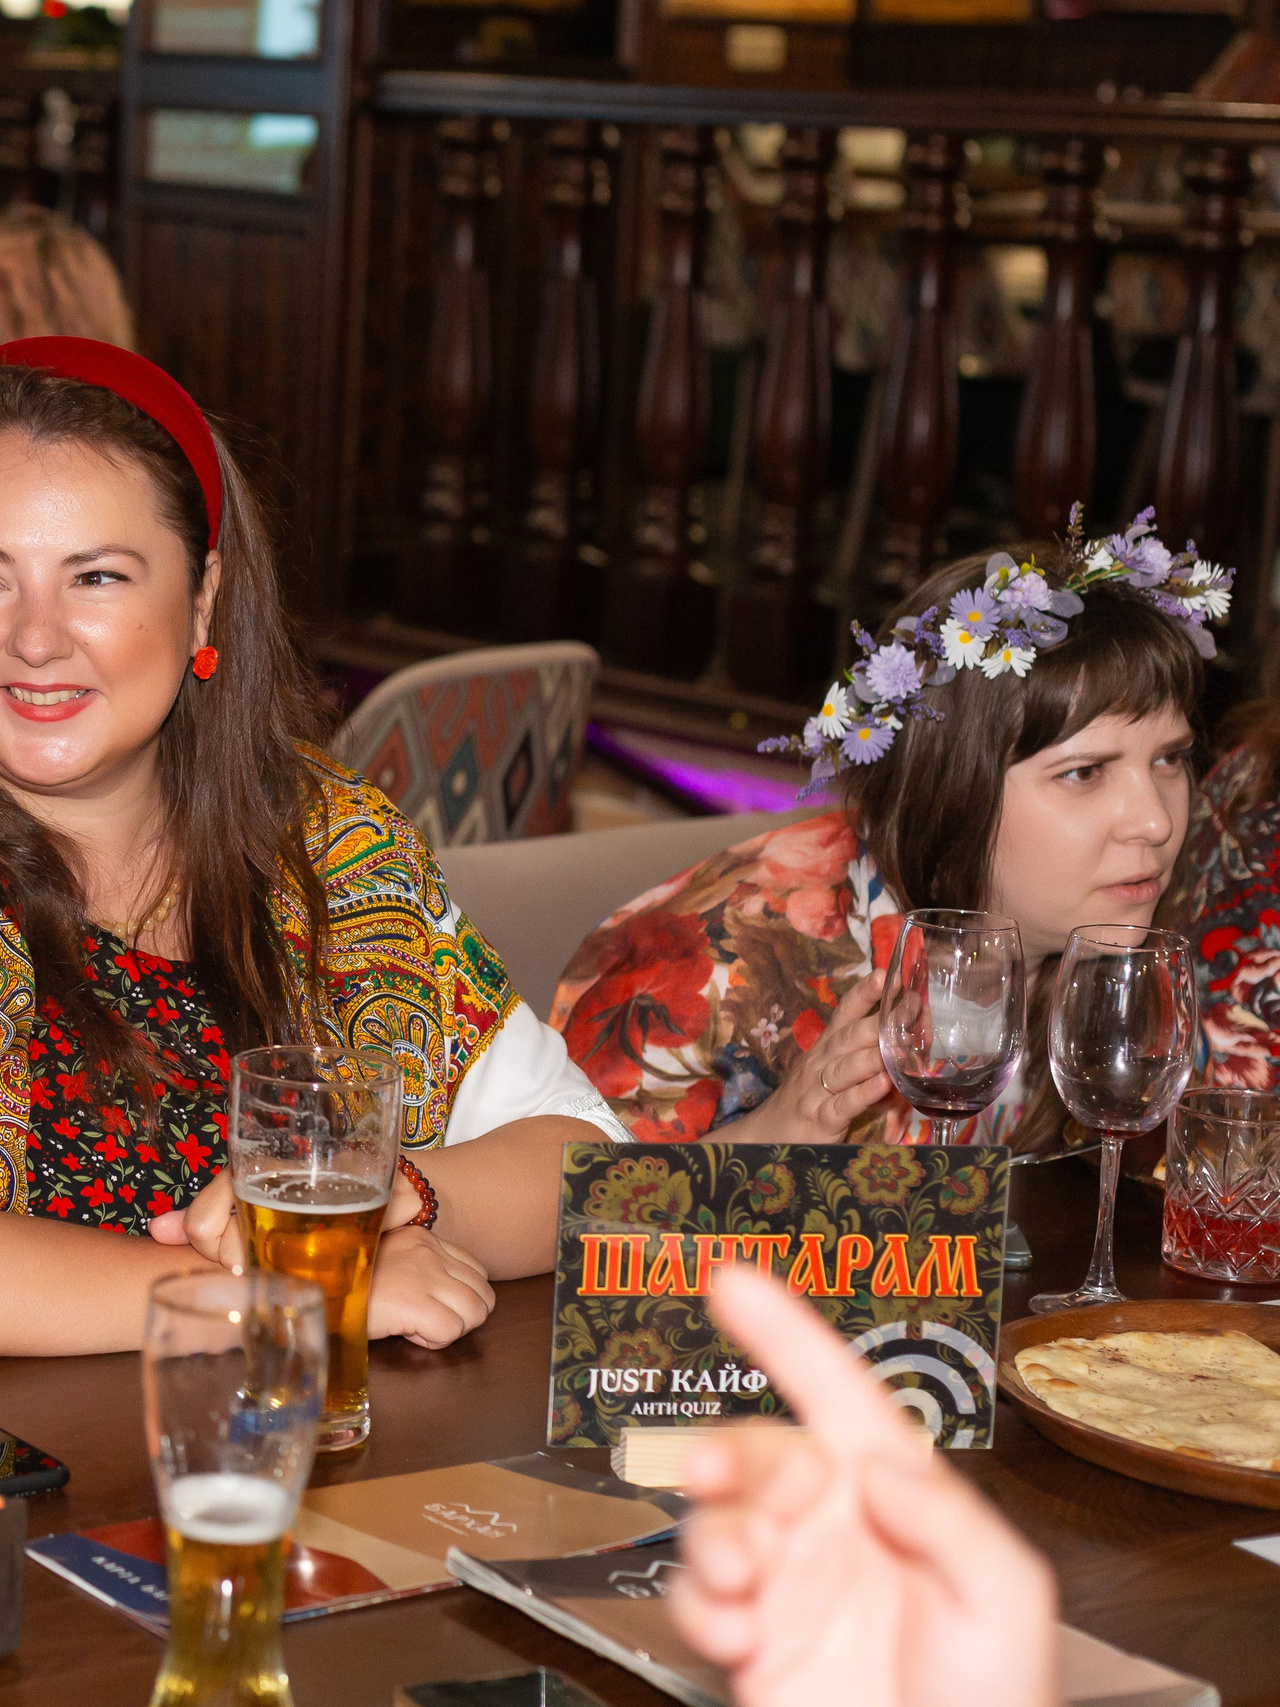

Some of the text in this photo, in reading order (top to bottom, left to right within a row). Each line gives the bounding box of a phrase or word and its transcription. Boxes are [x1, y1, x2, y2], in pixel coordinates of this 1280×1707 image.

[586, 1363, 768, 1399] JUST КАЙФ
[630, 1401, 722, 1418] АНТИ QUIZ
